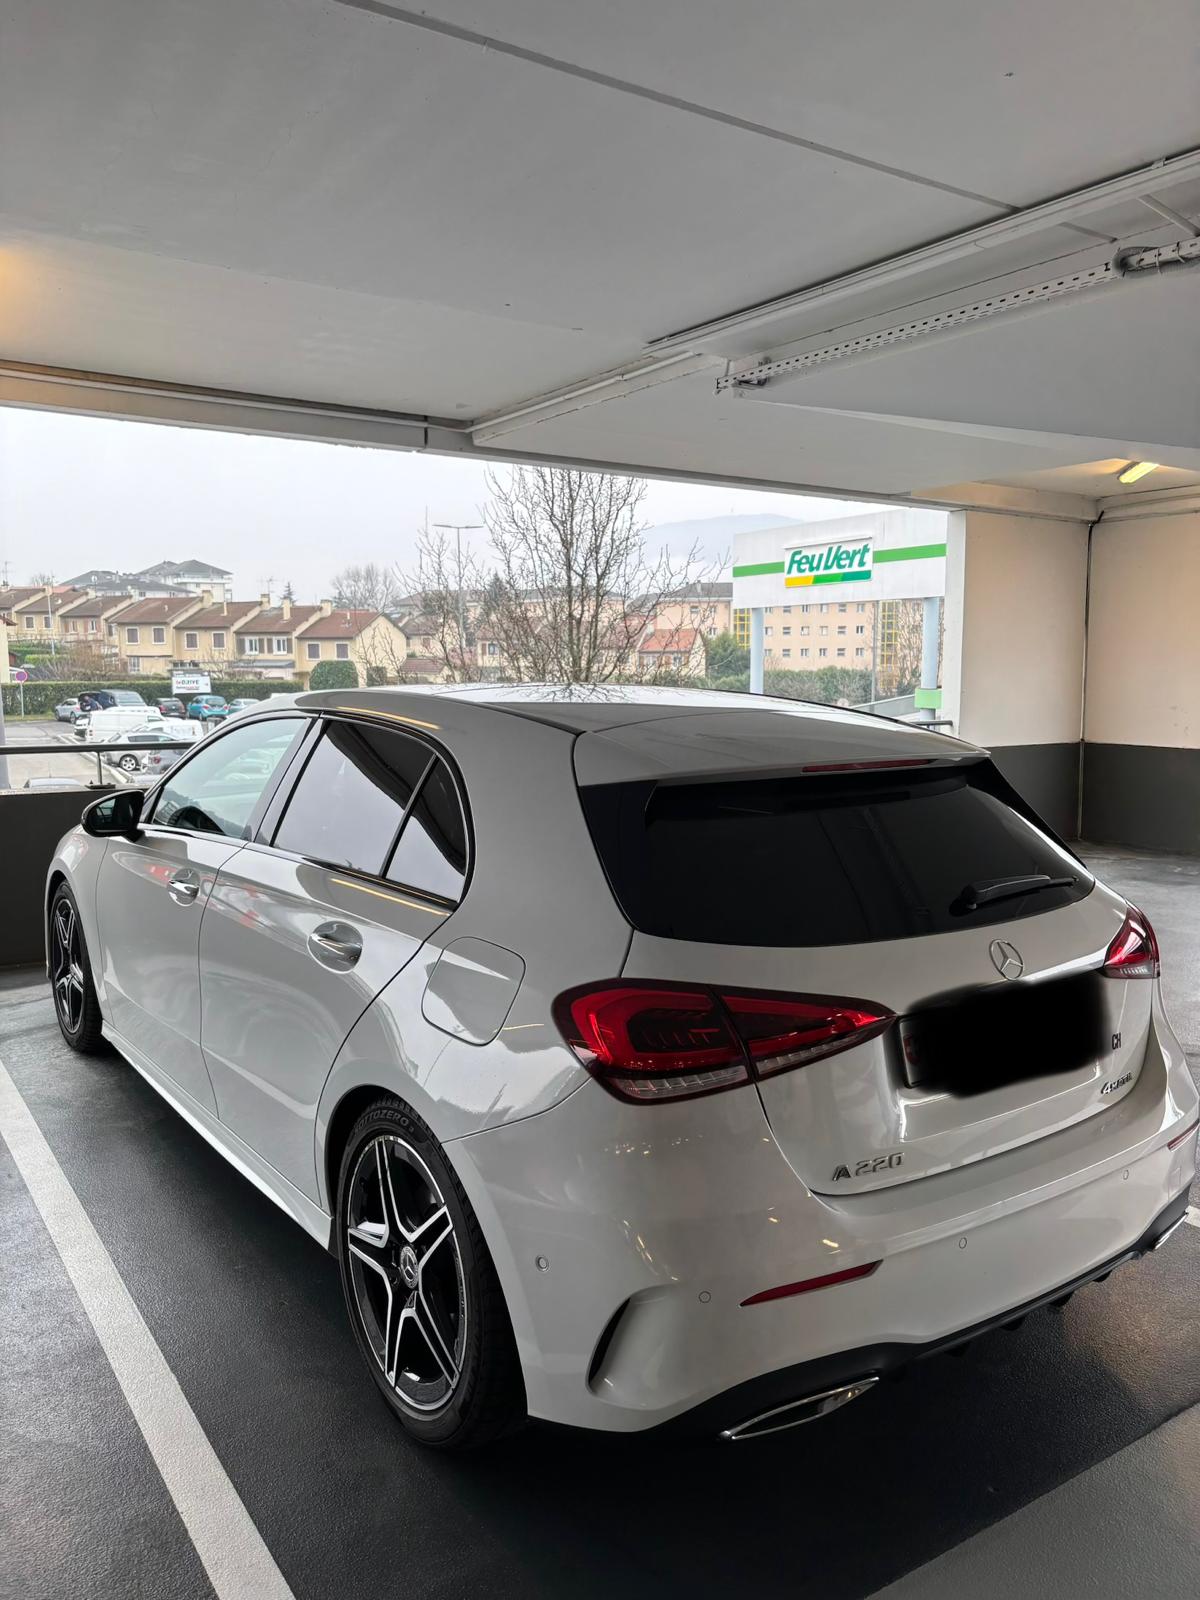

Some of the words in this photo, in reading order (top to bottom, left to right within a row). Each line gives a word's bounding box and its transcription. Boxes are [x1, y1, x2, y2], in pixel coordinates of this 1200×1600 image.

[787, 549, 824, 575] Feu
[823, 543, 871, 571] Vert
[1111, 1032, 1121, 1050] CH
[832, 1165, 853, 1181] A
[855, 1152, 905, 1176] 220
